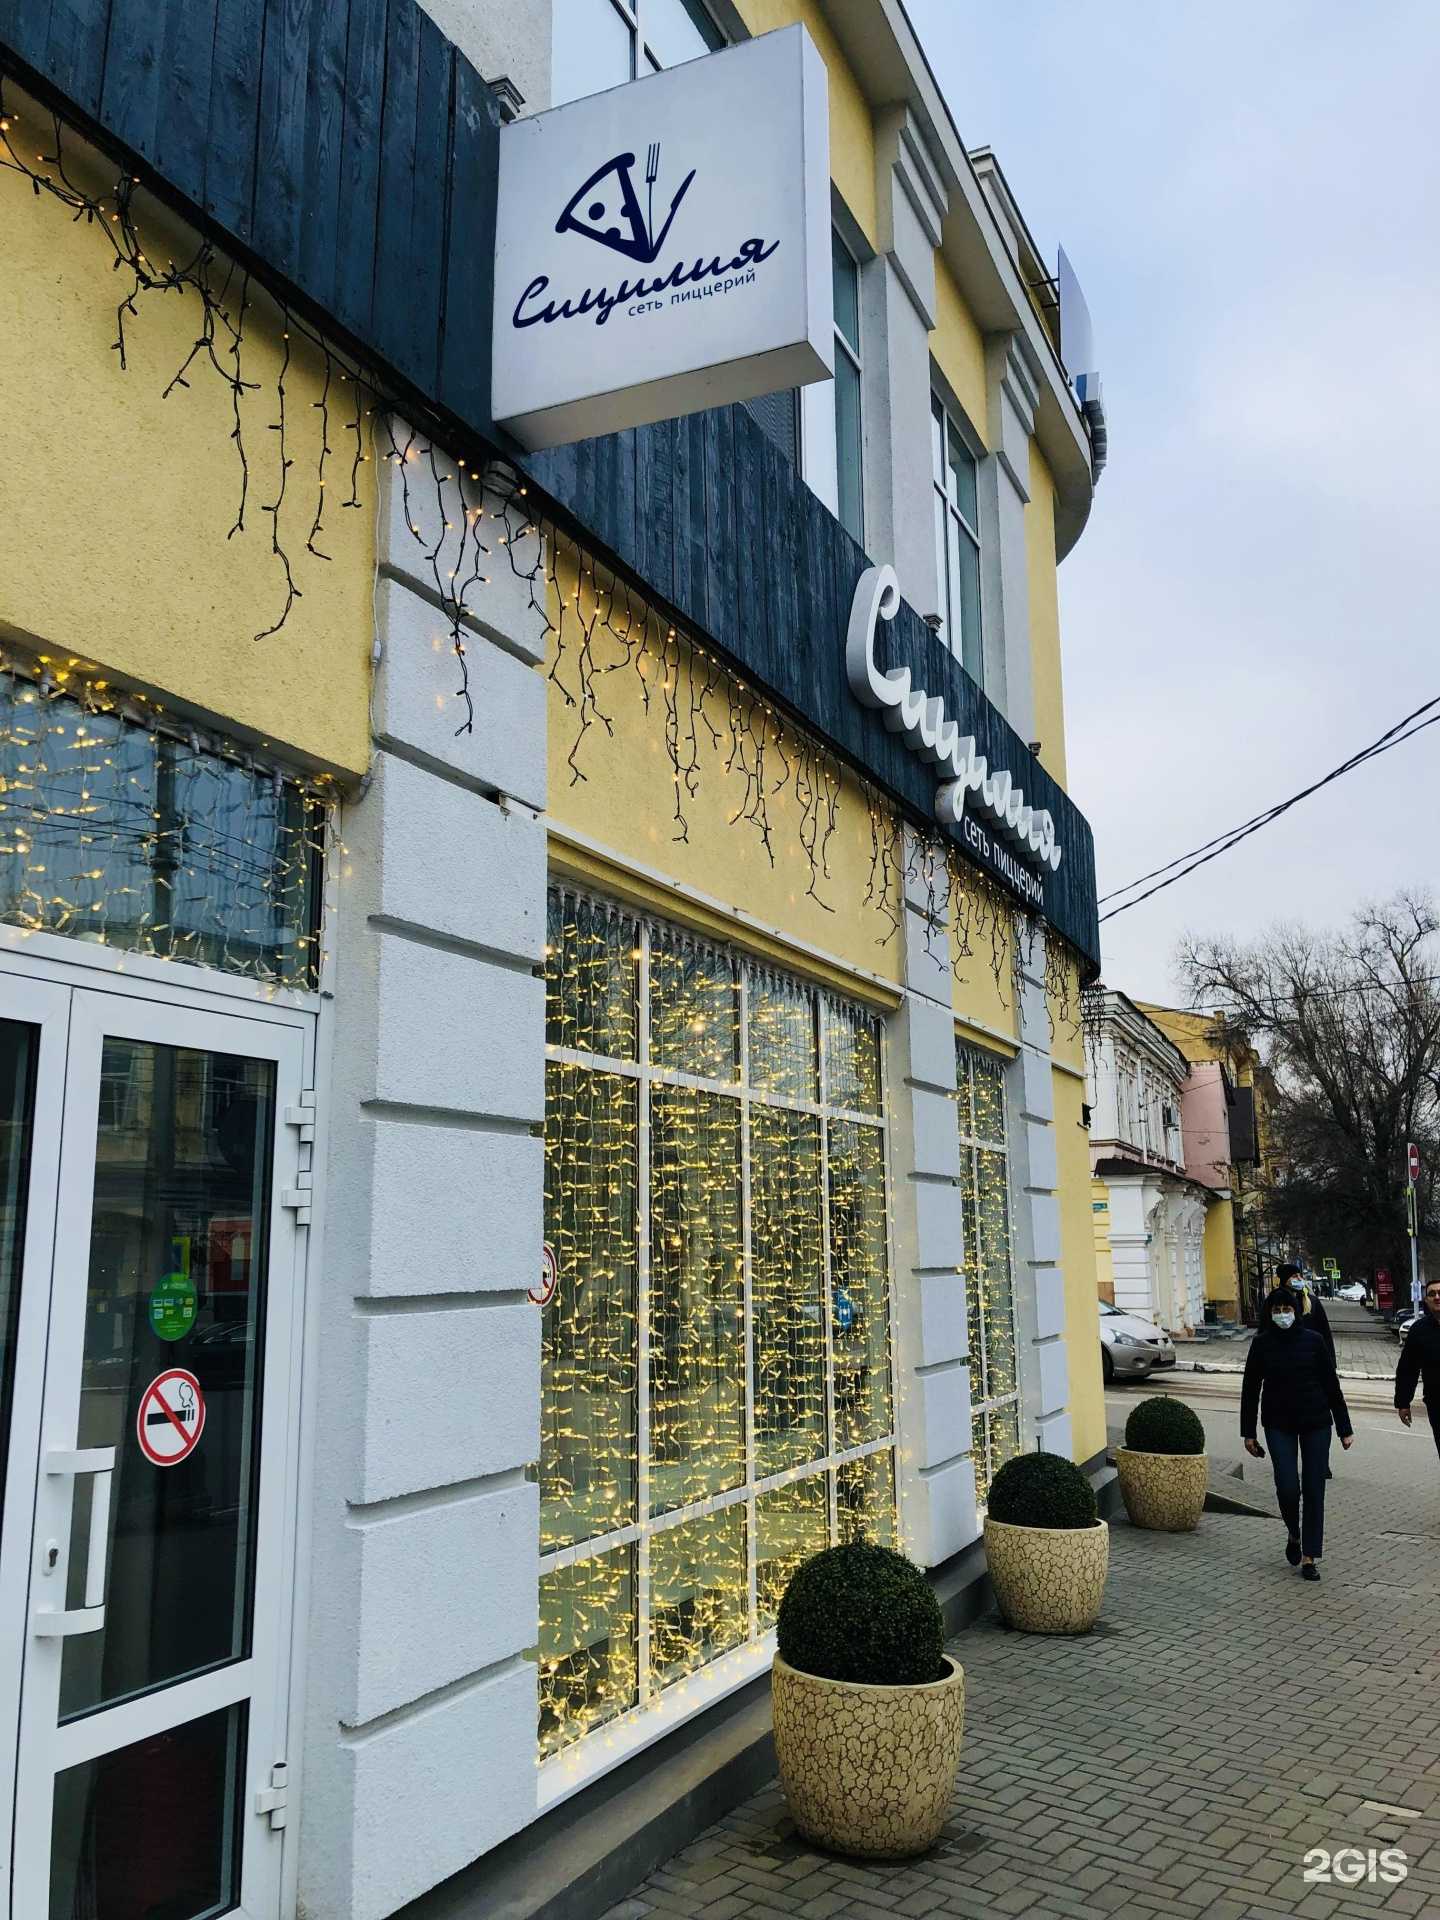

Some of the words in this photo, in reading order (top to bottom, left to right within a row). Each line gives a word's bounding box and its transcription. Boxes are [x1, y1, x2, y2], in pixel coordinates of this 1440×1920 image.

[512, 238, 780, 328] Сицилия
[628, 300, 663, 317] сеть
[671, 268, 756, 305] пиццерий
[846, 564, 1062, 872] Сицилия
[964, 815, 990, 858] сеть
[993, 841, 1044, 907] пиццерий
